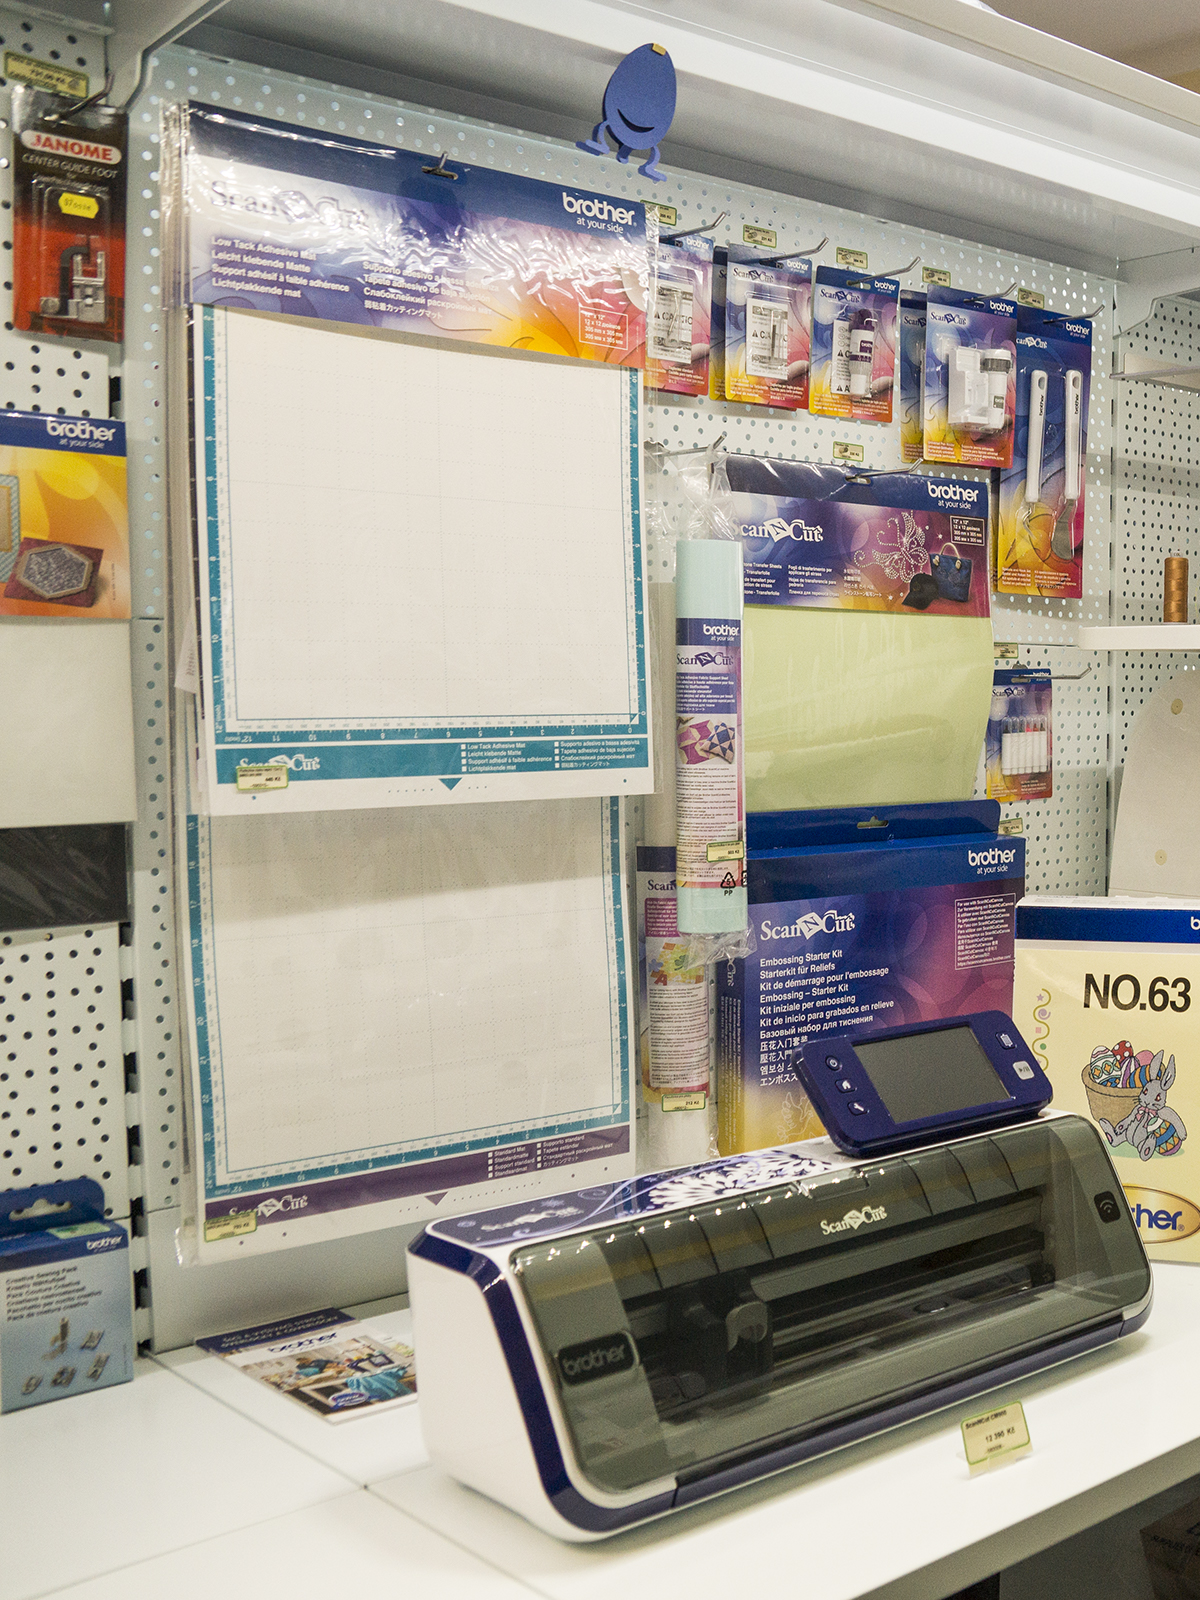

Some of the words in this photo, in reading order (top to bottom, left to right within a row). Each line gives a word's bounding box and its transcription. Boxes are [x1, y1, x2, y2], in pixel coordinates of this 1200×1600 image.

[31, 134, 113, 161] JANOME
[22, 153, 61, 168] CENTER
[60, 161, 90, 174] GUIDE
[90, 164, 118, 178] FOOT
[562, 191, 635, 226] brother
[576, 217, 586, 227] at
[587, 219, 606, 232] your
[606, 222, 624, 234] side
[212, 234, 231, 248] Low
[233, 239, 255, 252] Tack
[256, 243, 299, 258] Adhesive
[212, 250, 242, 263] Leicht
[243, 254, 285, 270] klebende
[286, 262, 311, 274] Matte
[362, 261, 402, 276] Supporto
[786, 258, 810, 272] brother
[212, 264, 246, 279] Support
[309, 278, 350, 293] adhérence
[732, 266, 775, 284] ScanNCut
[212, 278, 282, 296] Lichtplakkende
[284, 287, 302, 298] mat
[874, 280, 897, 292] brother
[363, 287, 426, 305] Слабоклейкий
[820, 288, 862, 304] ScanNCut
[989, 300, 1015, 314] brother
[930, 312, 967, 326] ScanNCut
[1065, 322, 1090, 336] brother
[1016, 336, 1048, 350] canNCut
[46, 420, 116, 442] brother
[58, 438, 68, 446] at
[68, 439, 86, 450] your
[88, 440, 104, 450] side
[927, 482, 979, 502] brother
[938, 500, 944, 508] at
[944, 501, 958, 510] your
[958, 502, 972, 510] side
[731, 516, 824, 543] ScanNCut
[703, 624, 740, 636] brother
[676, 651, 734, 668] ScanNCut
[468, 750, 485, 758] Leicht
[480, 742, 492, 750] Tack
[492, 742, 517, 750] Adhesive
[468, 758, 488, 766] Support
[468, 764, 506, 773] Lichtplakkende
[968, 848, 1016, 867] brother
[976, 866, 984, 874] at
[984, 866, 996, 875] your
[996, 864, 1009, 873] side
[760, 909, 856, 941] ScanNCut
[760, 954, 804, 968] Embossing
[805, 952, 830, 962] Starter
[832, 949, 843, 958] Kit
[760, 967, 796, 980] Starterkit
[798, 965, 809, 975] für
[810, 962, 836, 973] Reliefs
[760, 982, 772, 992] Kit
[772, 981, 784, 990] de
[784, 976, 826, 988] démarrage
[826, 974, 844, 984] pour
[844, 967, 890, 980] l'embossage
[760, 991, 804, 1004] Embossing
[811, 986, 837, 996] Starter
[838, 983, 849, 992] Kit
[1082, 972, 1192, 1013] NO.63
[760, 1006, 772, 1015] Kit
[773, 1002, 800, 1013] iniziale
[802, 1001, 814, 1011] per
[815, 994, 856, 1007] embossing
[760, 1018, 772, 1028] Kit
[773, 1016, 784, 1026] de
[784, 1014, 806, 1024] inicio
[807, 1012, 824, 1023] para
[825, 1006, 860, 1020] grabados
[860, 1004, 870, 1012] en
[870, 1000, 895, 1010] relieve
[760, 1026, 796, 1040] Базовый
[797, 1022, 822, 1034] набор
[822, 1021, 838, 1032] для
[838, 1015, 874, 1027] тиснения
[760, 1063, 785, 1077] 엠보싱
[494, 1148, 516, 1156] Standard
[820, 1204, 888, 1236] ScanNCut
[563, 1342, 627, 1376] brother
[985, 1434, 993, 1443] 12
[1006, 1426, 1016, 1436] Kč
